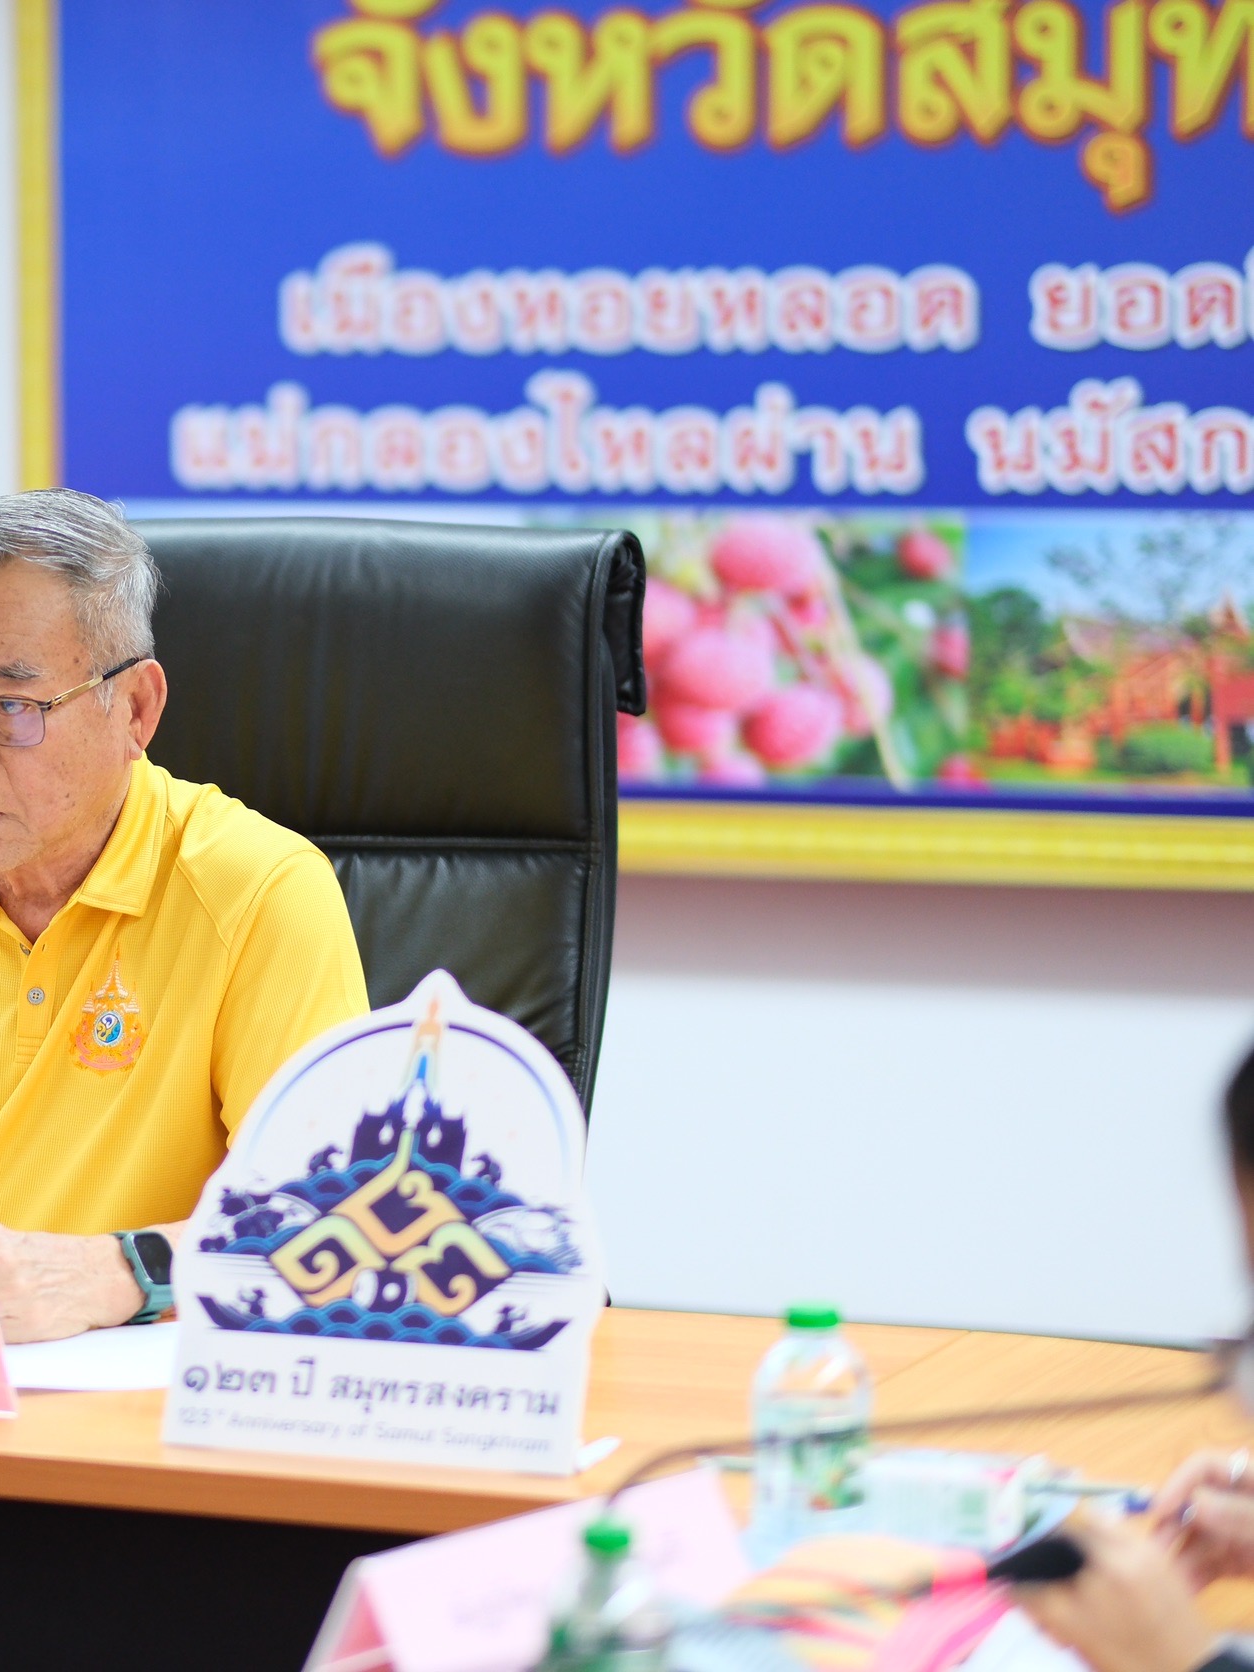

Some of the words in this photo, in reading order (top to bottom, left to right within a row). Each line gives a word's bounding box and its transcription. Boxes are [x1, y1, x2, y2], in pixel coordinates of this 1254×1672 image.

[313, 0, 1254, 212] จงหวดสมุท
[1029, 244, 1254, 352] ยอด
[182, 1361, 277, 1393] ๑๒๓
[291, 1355, 317, 1397] ปี
[329, 1373, 560, 1415] สมุทรสงคราม
